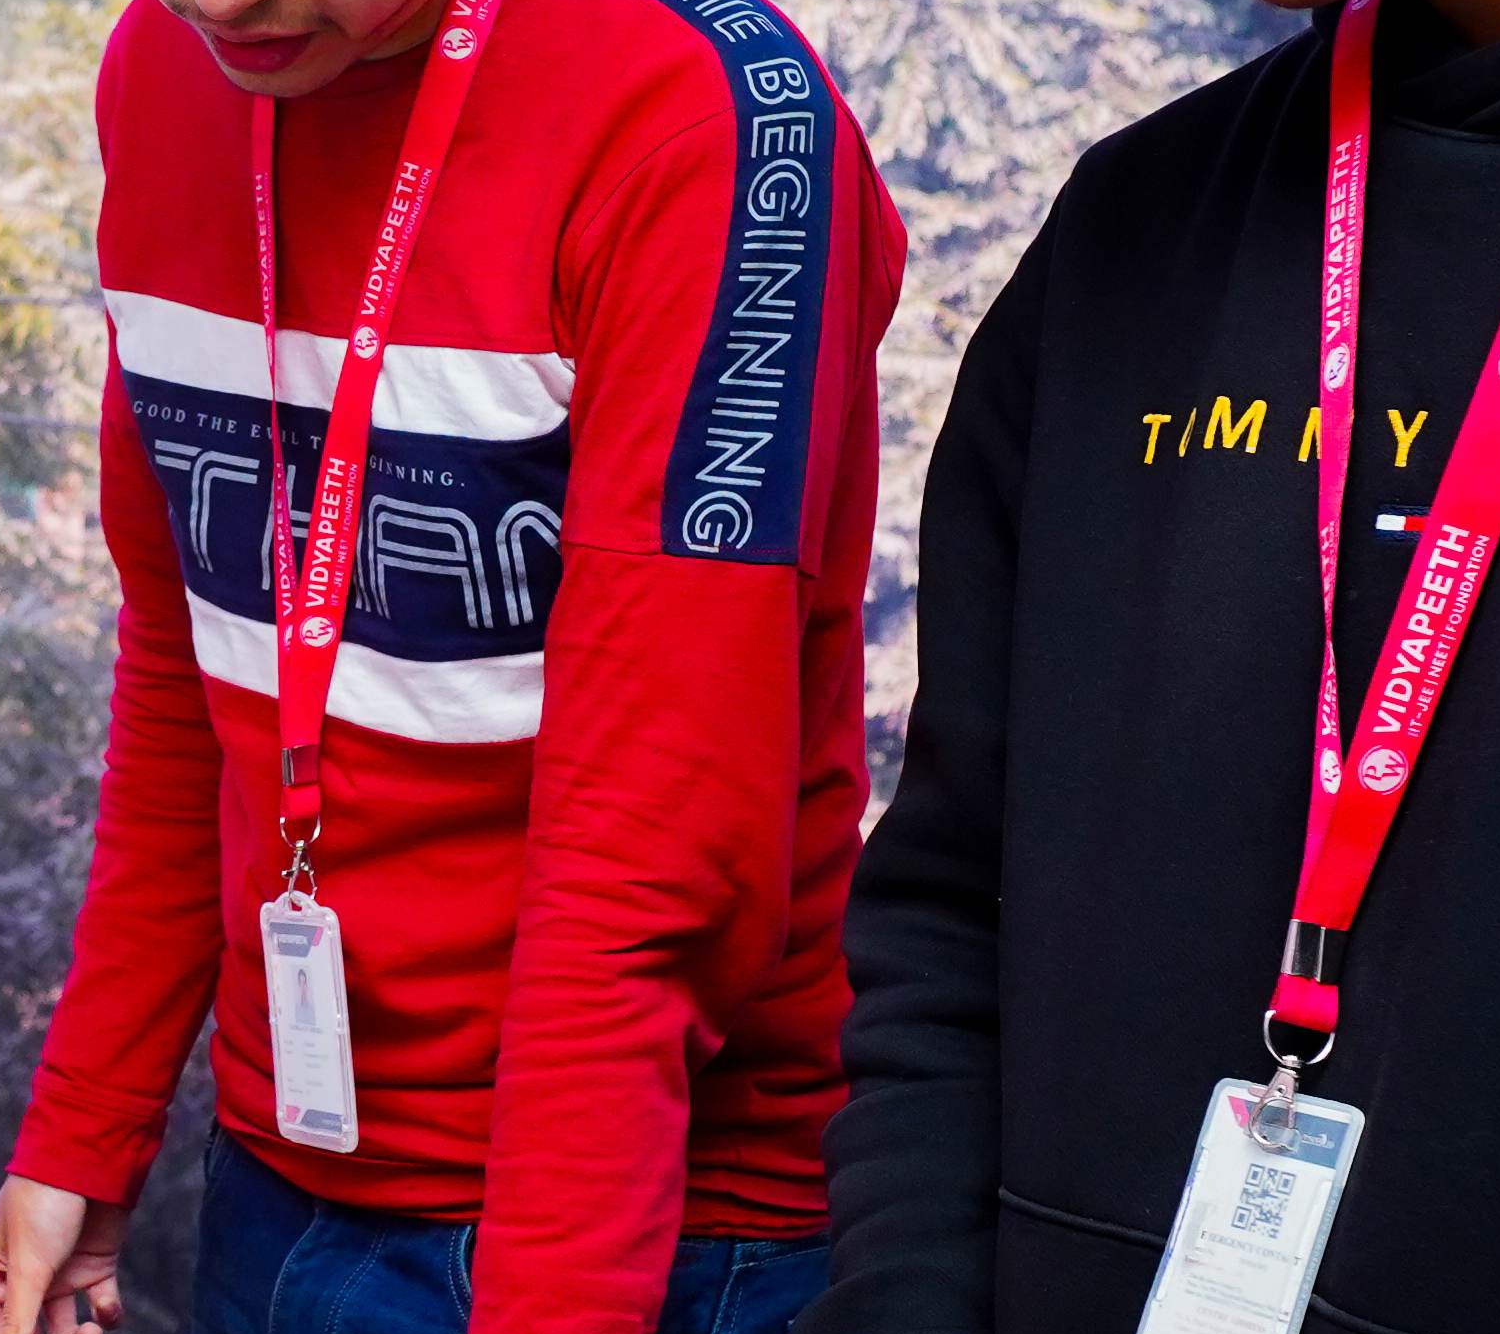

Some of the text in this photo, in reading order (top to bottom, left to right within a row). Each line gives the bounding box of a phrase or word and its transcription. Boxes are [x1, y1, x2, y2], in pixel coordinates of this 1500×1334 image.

[361, 161, 420, 315] VIDYAPEETH
[402, 168, 433, 240] FOUNDATION
[1326, 140, 1352, 342] VIDYAPEETH
[682, 57, 815, 553] BEGINNING
[132, 400, 187, 423] GOOD
[197, 413, 239, 434] THE
[306, 457, 347, 608] VIDYAPEETH
[342, 463, 359, 532] FOUNDATION
[1373, 524, 1471, 733] VIDYAPEETH
[1407, 535, 1491, 738] IIT-JEE NEET FOUNDATION
